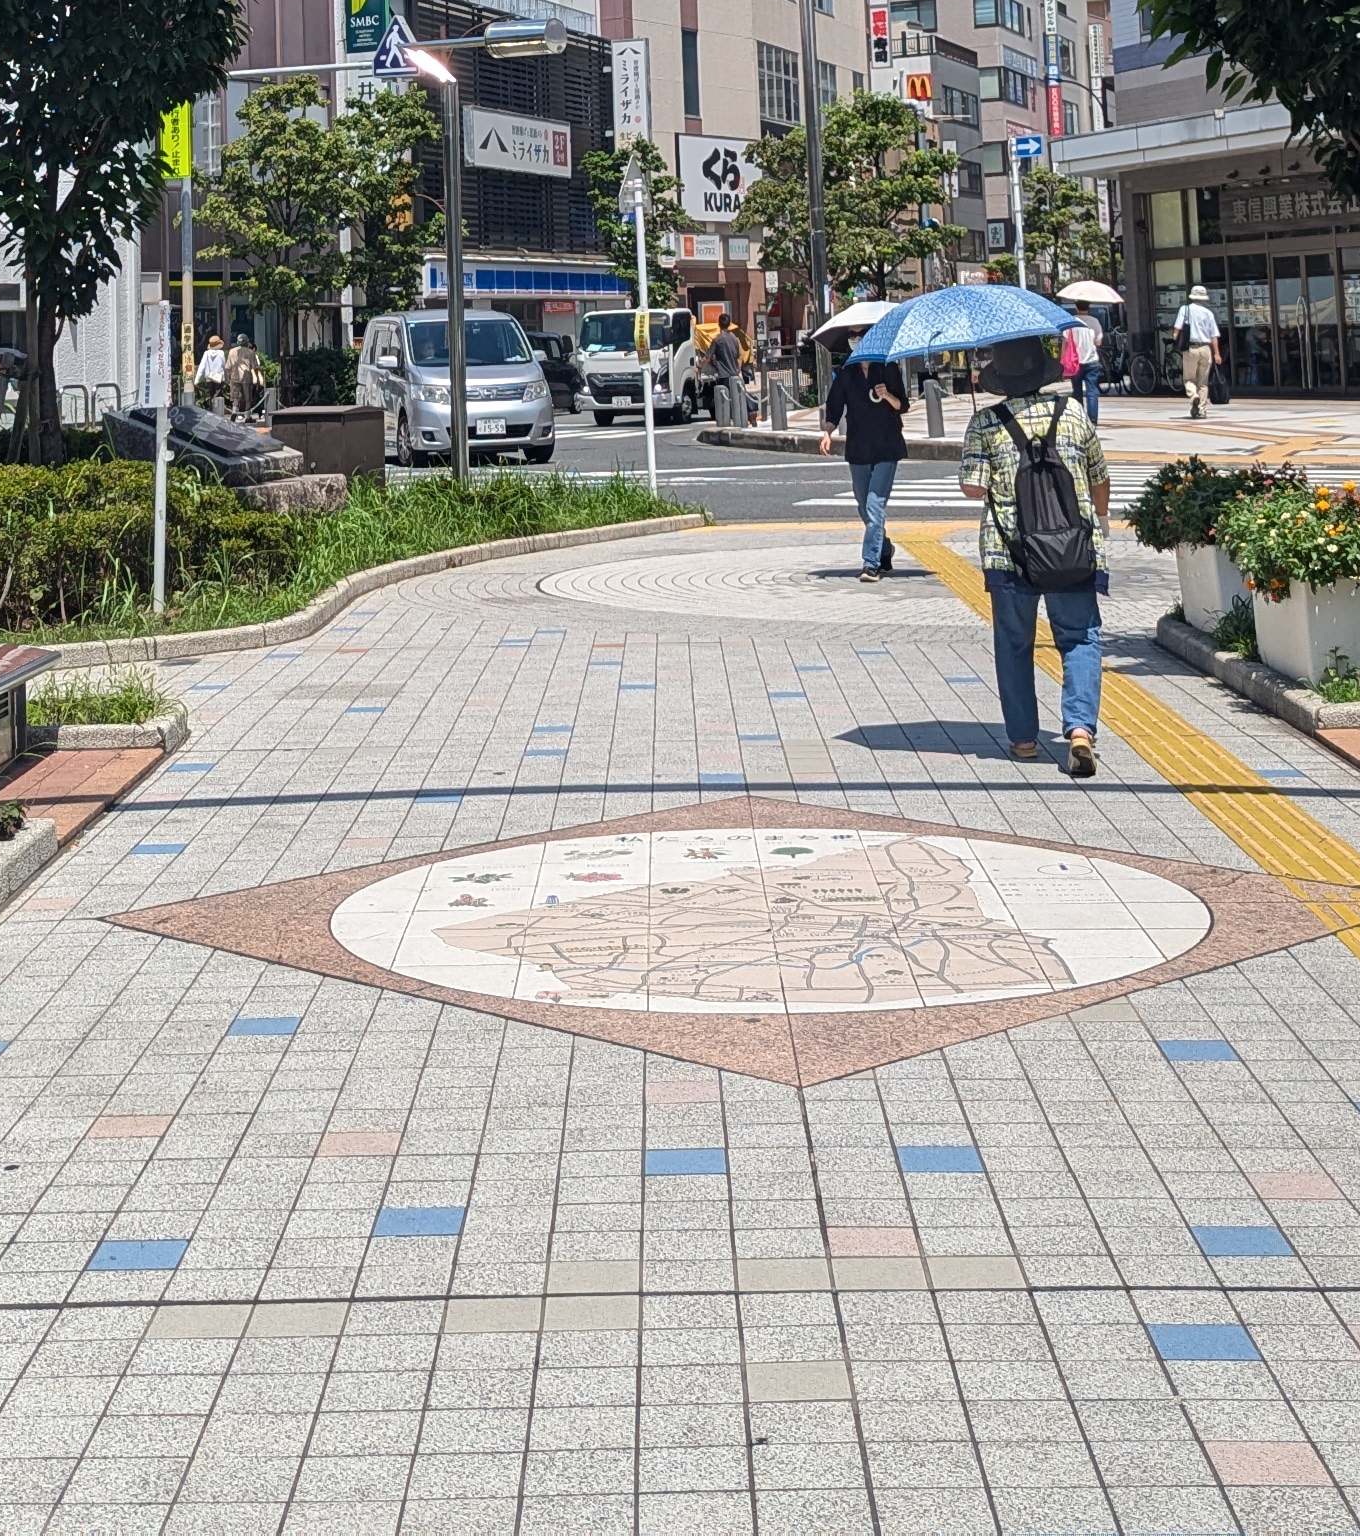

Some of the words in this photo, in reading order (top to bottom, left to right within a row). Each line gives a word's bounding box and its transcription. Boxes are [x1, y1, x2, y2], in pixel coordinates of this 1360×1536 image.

[349, 14, 380, 29] SMBC
[619, 59, 633, 125] ミライザカ
[512, 139, 550, 164] ミライザカ
[554, 134, 565, 151] 2F
[702, 146, 741, 192] くら
[703, 191, 741, 213] KURA
